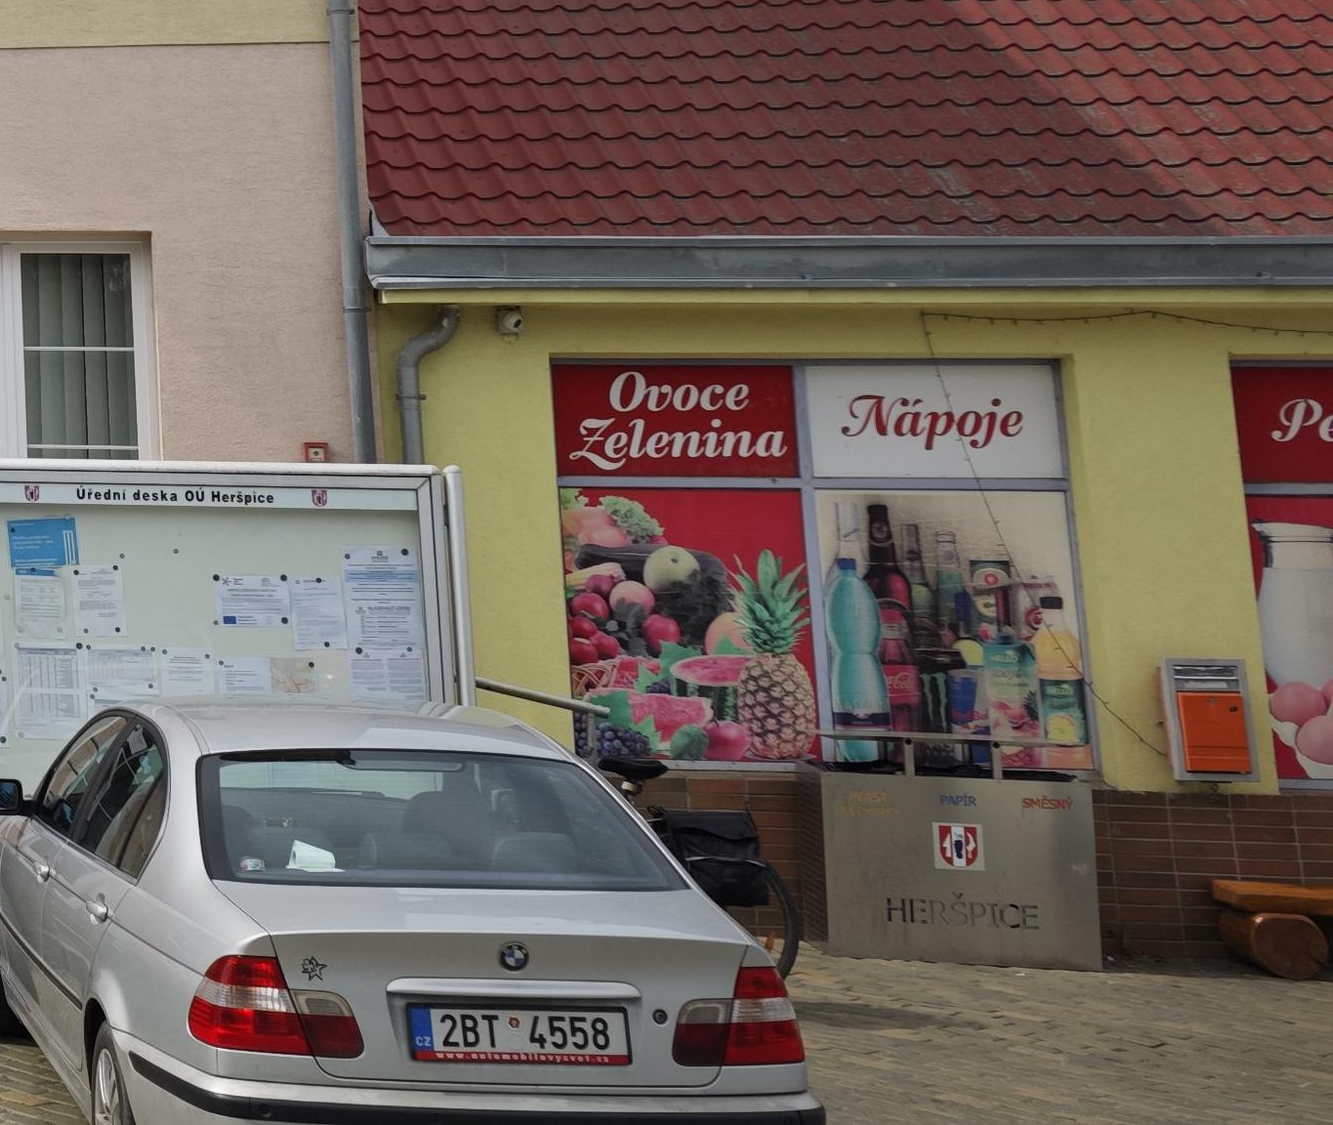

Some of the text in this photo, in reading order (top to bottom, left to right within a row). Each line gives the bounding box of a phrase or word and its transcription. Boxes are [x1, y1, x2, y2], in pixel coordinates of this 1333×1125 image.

[609, 371, 750, 412] Ovoce
[841, 394, 1023, 451] Nápoje
[569, 417, 788, 471] Zelenina
[76, 485, 275, 506] Úřední deska OÚ Heršpice
[940, 792, 977, 806] PAPÍR
[1022, 795, 1074, 810] SMĚSNÝ
[886, 891, 1040, 930] HERŠPICE
[416, 1036, 431, 1047] CZ
[440, 1013, 610, 1051] 2BT 4558
